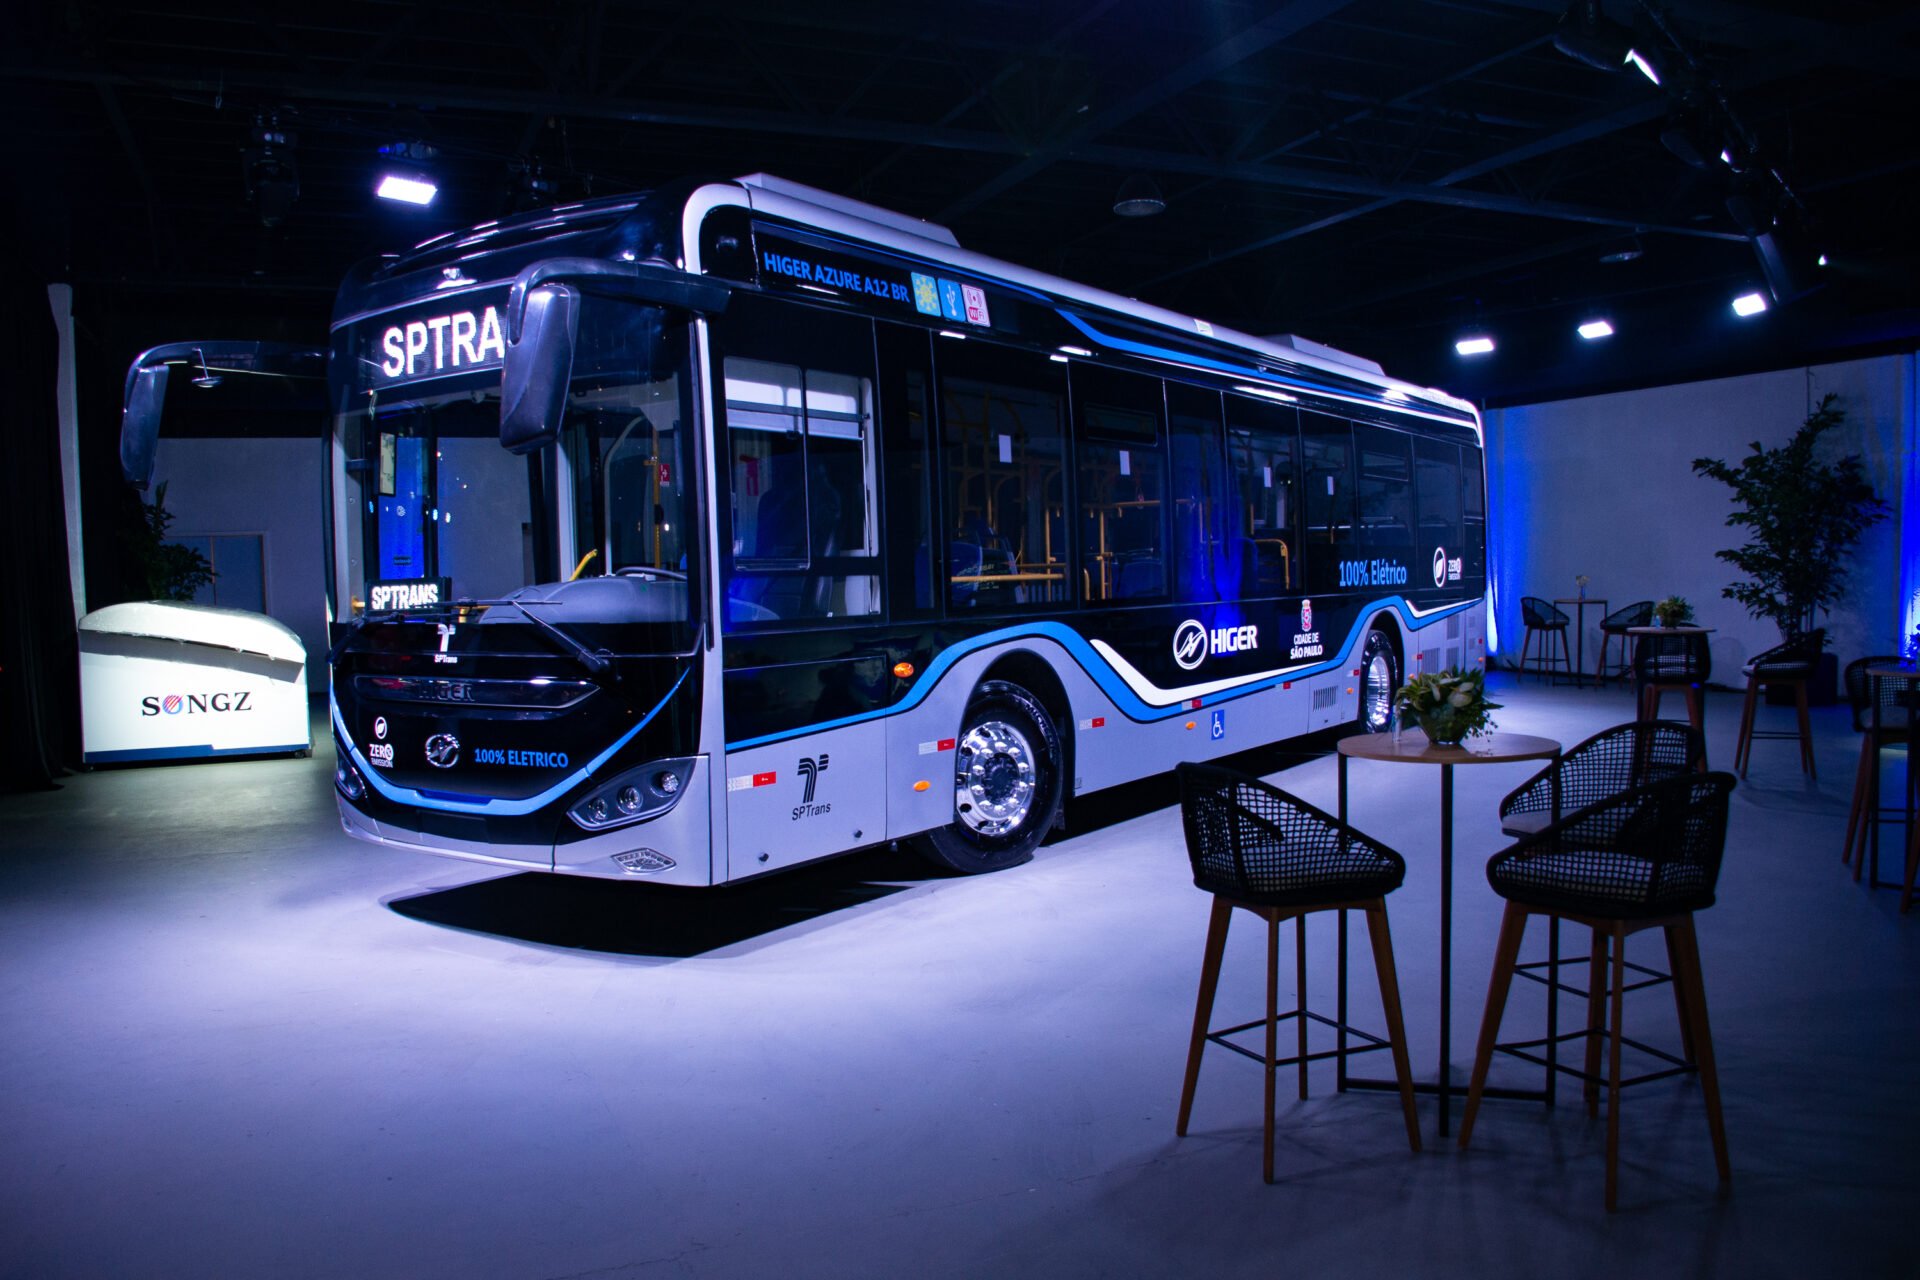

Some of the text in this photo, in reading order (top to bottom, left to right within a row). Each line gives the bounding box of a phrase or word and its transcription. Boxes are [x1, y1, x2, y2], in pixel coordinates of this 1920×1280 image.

[764, 252, 910, 303] HIGER AZURE A12 BR
[383, 306, 504, 377] SPTRA
[1339, 559, 1407, 587] 100% Elétrico
[371, 584, 438, 610] SPTRANS
[1210, 625, 1257, 654] HIGER
[1293, 632, 1319, 645] CIDADE DE
[1290, 645, 1323, 659] SÃO PAULO
[142, 692, 252, 716] SONGZ
[369, 743, 394, 760] ZERO
[475, 748, 568, 768] 100% ELETRICO
[792, 803, 831, 821] SPTrans
